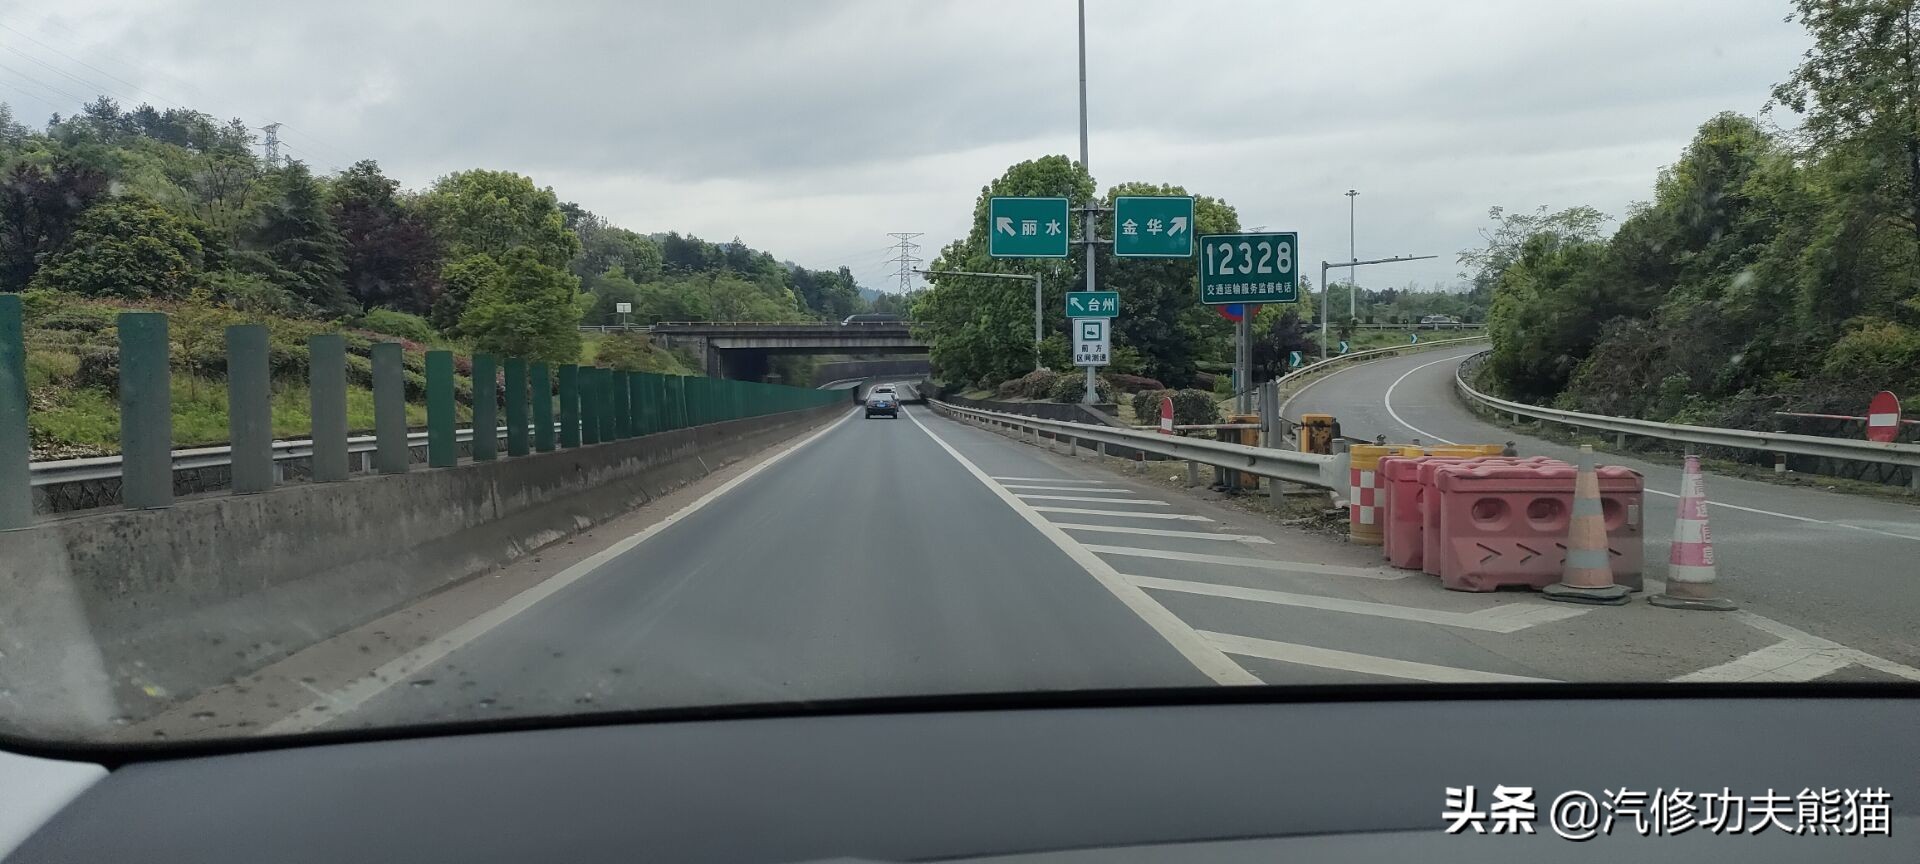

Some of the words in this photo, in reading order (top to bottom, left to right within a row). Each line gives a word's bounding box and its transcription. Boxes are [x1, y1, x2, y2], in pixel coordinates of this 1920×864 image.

[1021, 219, 1062, 236] 丽水
[1121, 218, 1163, 236] 金华
[1206, 241, 1292, 276] 12328
[1207, 281, 1292, 296] 交通运输服务监督电话
[1088, 297, 1115, 312] 台州
[1081, 344, 1103, 353] 前方
[1076, 353, 1107, 363] 区间测速
